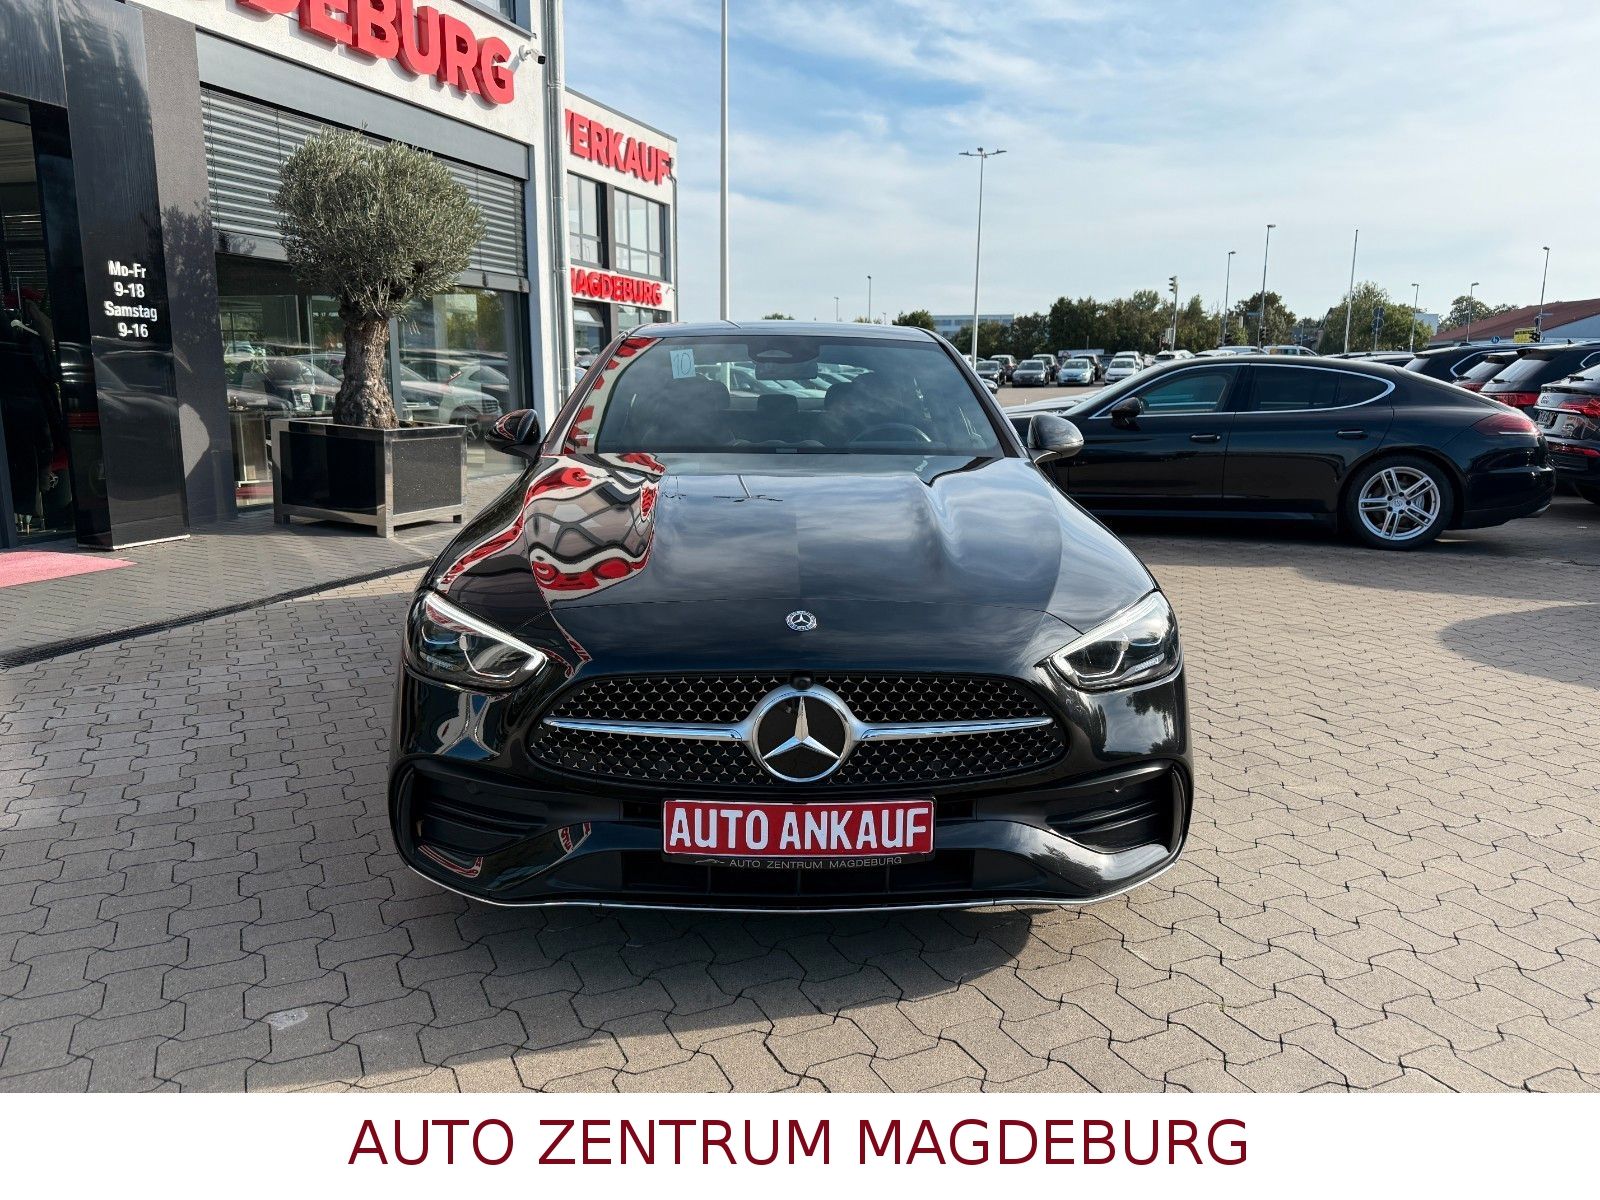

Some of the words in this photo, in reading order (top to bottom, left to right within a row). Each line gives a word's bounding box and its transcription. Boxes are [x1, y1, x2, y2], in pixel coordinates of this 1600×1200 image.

[230, 0, 515, 105] EBURG
[108, 260, 147, 278] Mo-Fr
[113, 281, 145, 298] 9-18
[570, 267, 663, 307] AGDEBURG
[103, 300, 158, 322] Samstag
[117, 322, 149, 338] 9-16
[669, 807, 769, 850] AUTO
[779, 807, 929, 850] ANKAUF
[729, 859, 761, 868] AUTO
[766, 860, 823, 869] ZENTRUM
[829, 856, 902, 869] MAGDEBURG
